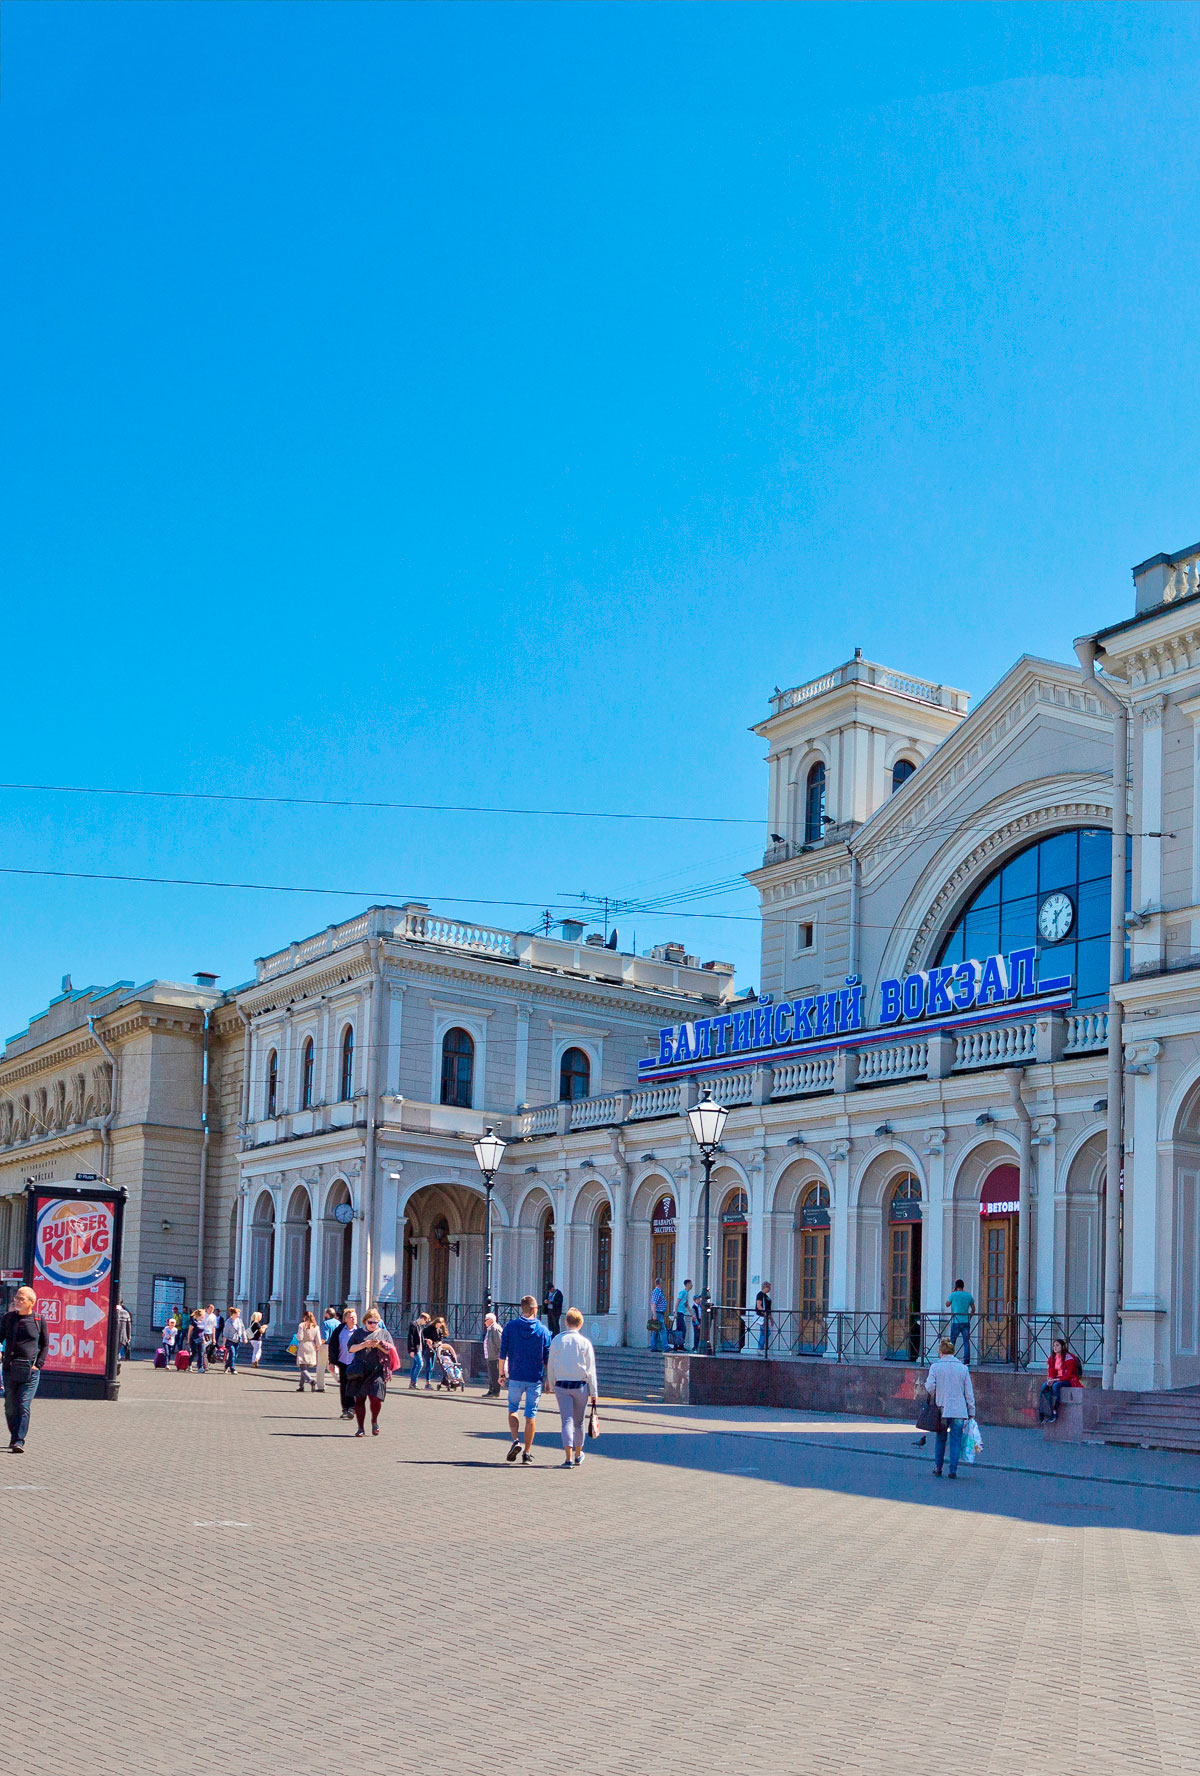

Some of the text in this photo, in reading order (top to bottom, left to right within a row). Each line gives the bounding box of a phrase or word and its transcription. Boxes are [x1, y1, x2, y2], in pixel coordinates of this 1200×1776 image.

[659, 946, 1036, 1066] БАЛТИЙСКИЙ ВОКЗАЛ
[42, 1214, 107, 1244] BURGER
[43, 1229, 109, 1266] KING
[41, 1301, 57, 1315] 24
